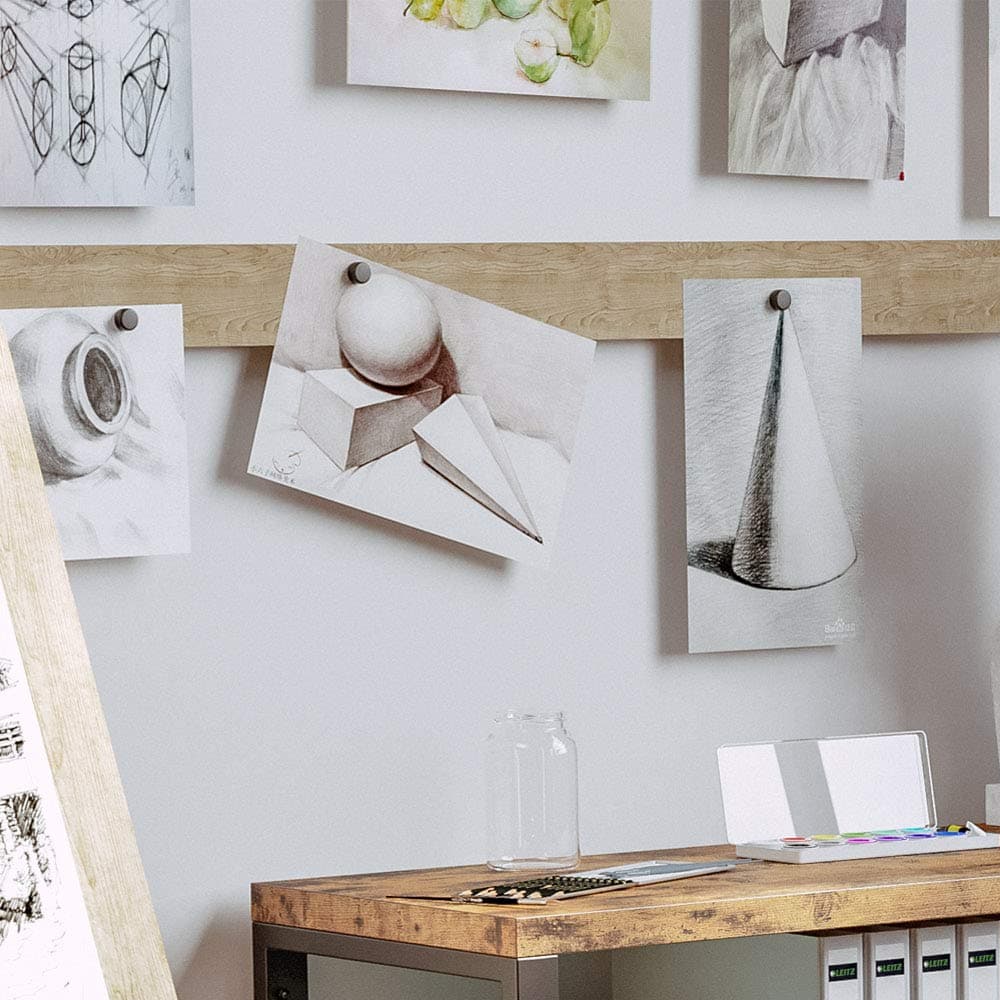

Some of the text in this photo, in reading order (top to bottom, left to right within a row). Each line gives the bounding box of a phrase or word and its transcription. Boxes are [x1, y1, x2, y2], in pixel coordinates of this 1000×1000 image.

[928, 958, 949, 968] LEITZ
[975, 953, 994, 963] LEITZ
[882, 962, 902, 972] LEITZ
[836, 968, 856, 977] LEITZ
